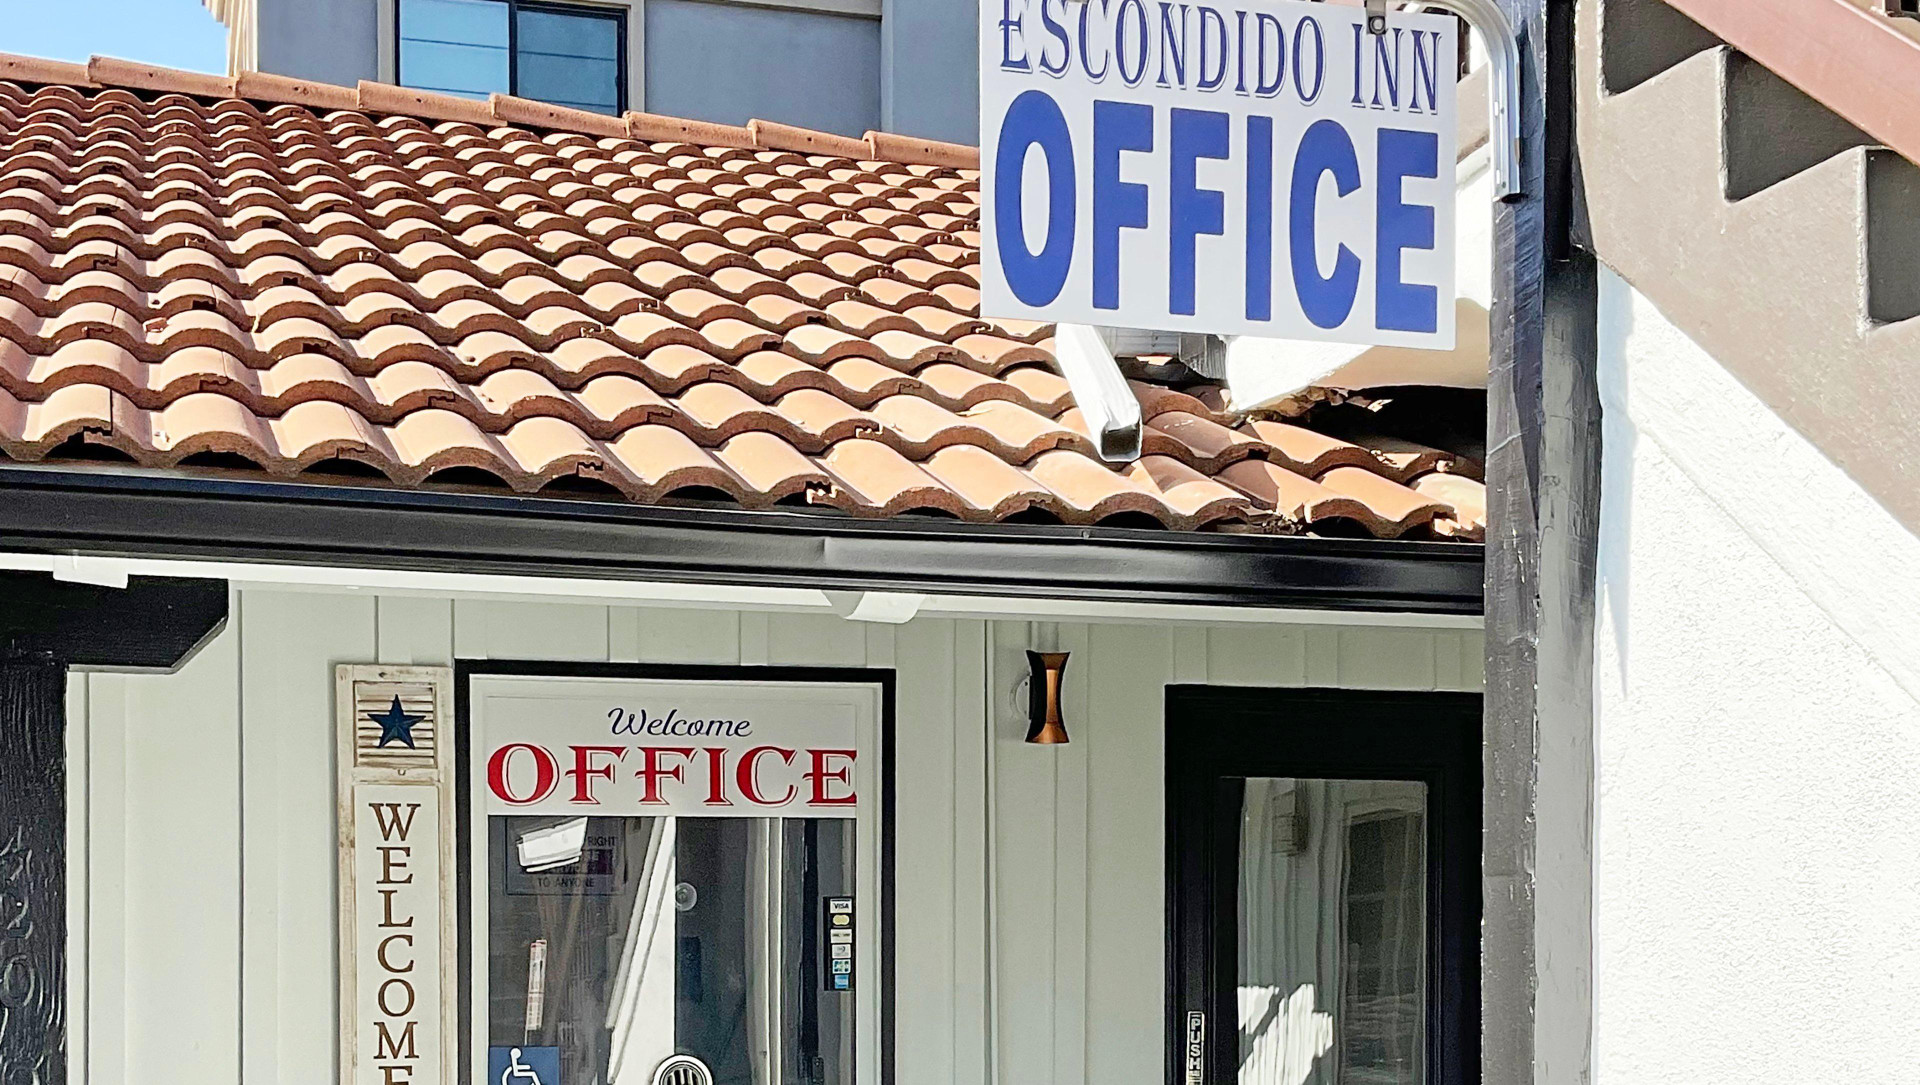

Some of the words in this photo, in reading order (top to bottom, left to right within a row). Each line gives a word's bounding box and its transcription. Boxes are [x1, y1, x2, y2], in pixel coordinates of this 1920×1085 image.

[998, 0, 1327, 107] ESCONDIDO
[1350, 23, 1442, 115] INN
[995, 90, 1439, 334] OFFICE
[607, 707, 753, 738] Welcome
[487, 742, 857, 807] OFFICE
[587, 836, 616, 847] RIGHT
[537, 878, 551, 888] TO
[1189, 1018, 1201, 1070] PUSH
